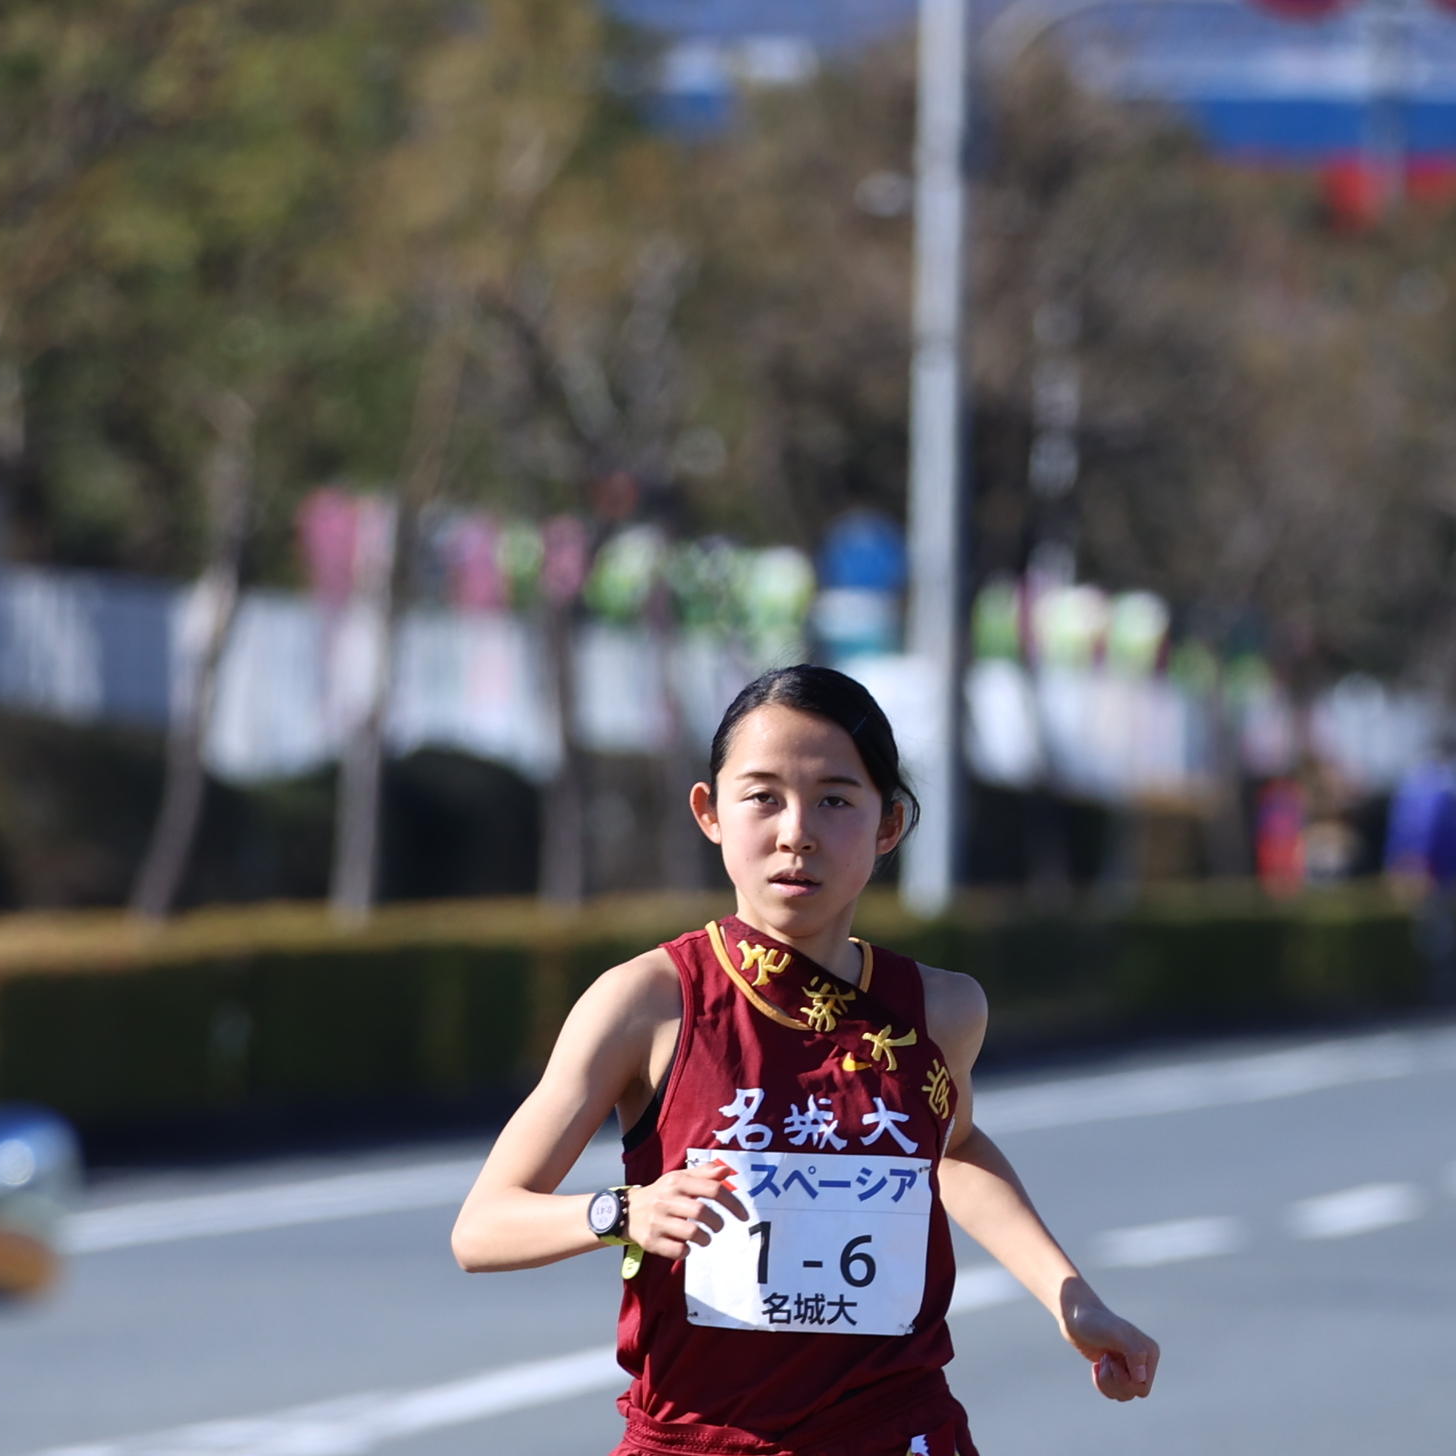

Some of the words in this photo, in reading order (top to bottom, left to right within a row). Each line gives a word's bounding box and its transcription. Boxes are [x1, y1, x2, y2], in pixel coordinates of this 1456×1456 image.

[712, 1088, 919, 1155] 名城大
[748, 1163, 918, 1203] スペーシア
[762, 1292, 859, 1326] 名城大
